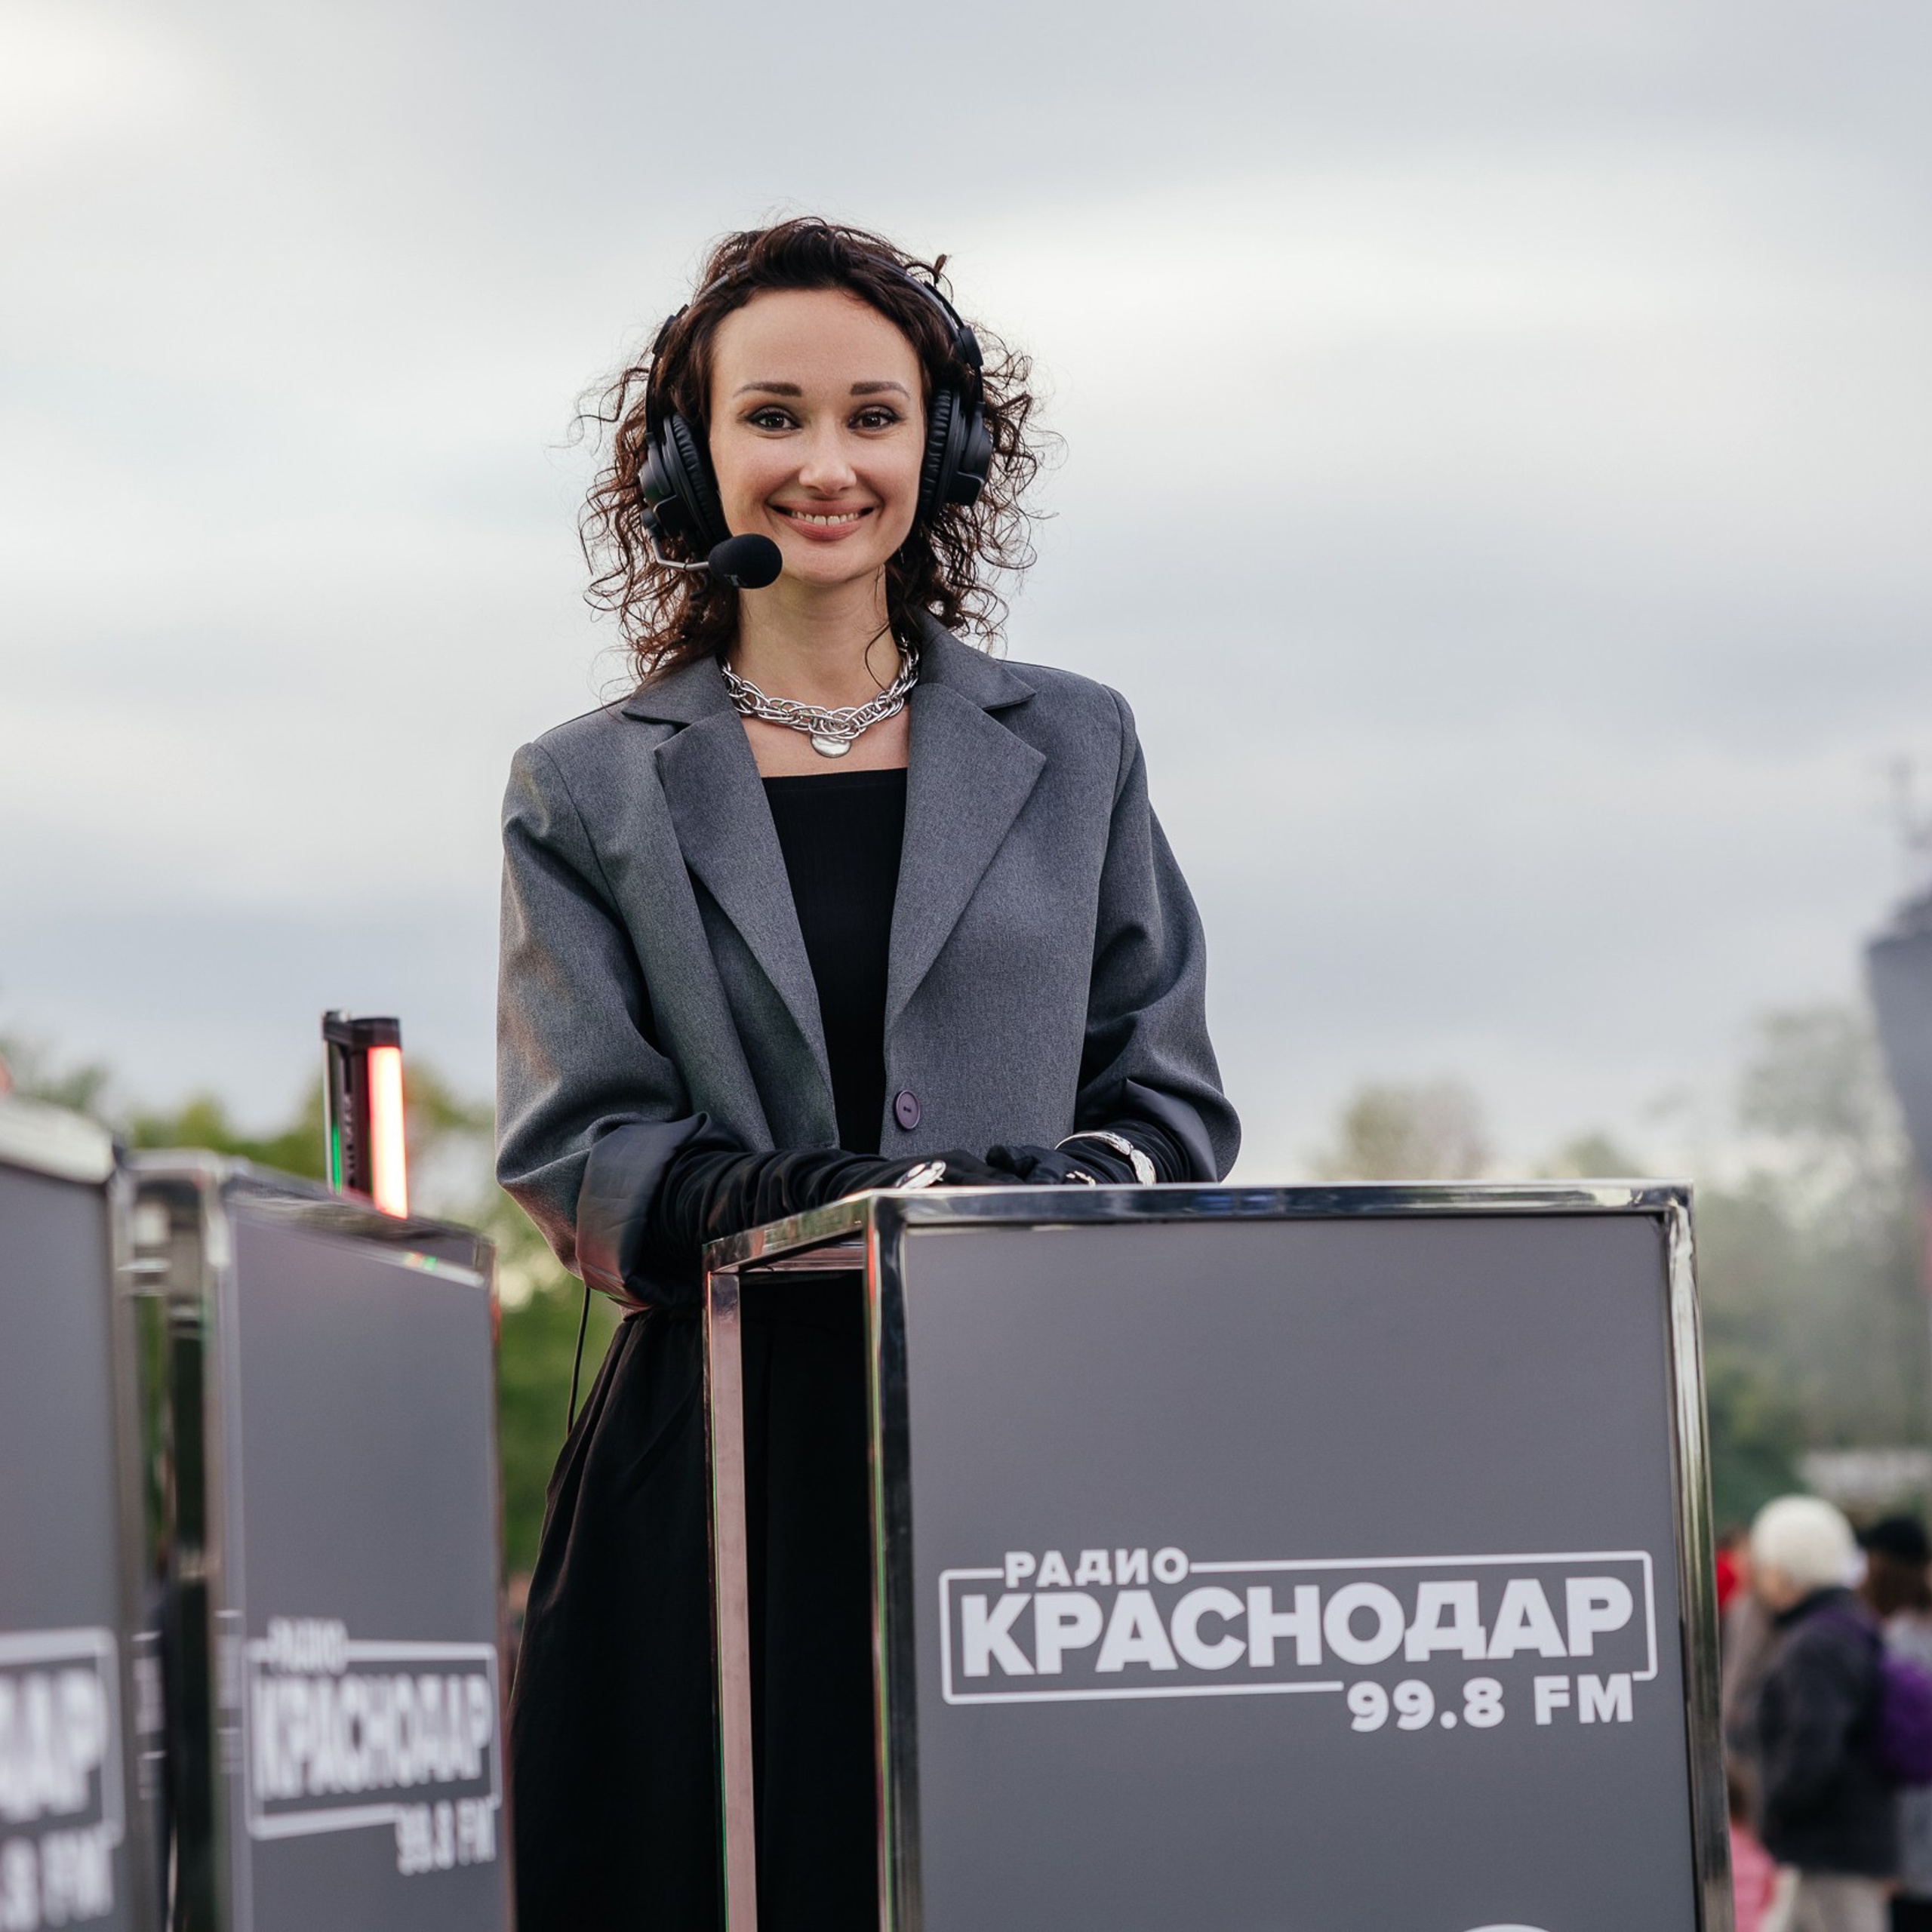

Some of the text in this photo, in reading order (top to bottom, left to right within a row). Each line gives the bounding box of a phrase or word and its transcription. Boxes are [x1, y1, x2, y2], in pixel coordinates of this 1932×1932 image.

[1005, 1547, 1189, 1588] РАДИО
[961, 1577, 1633, 1677] КРАСНОДАР
[1348, 1674, 1633, 1731] 99.8 FM
